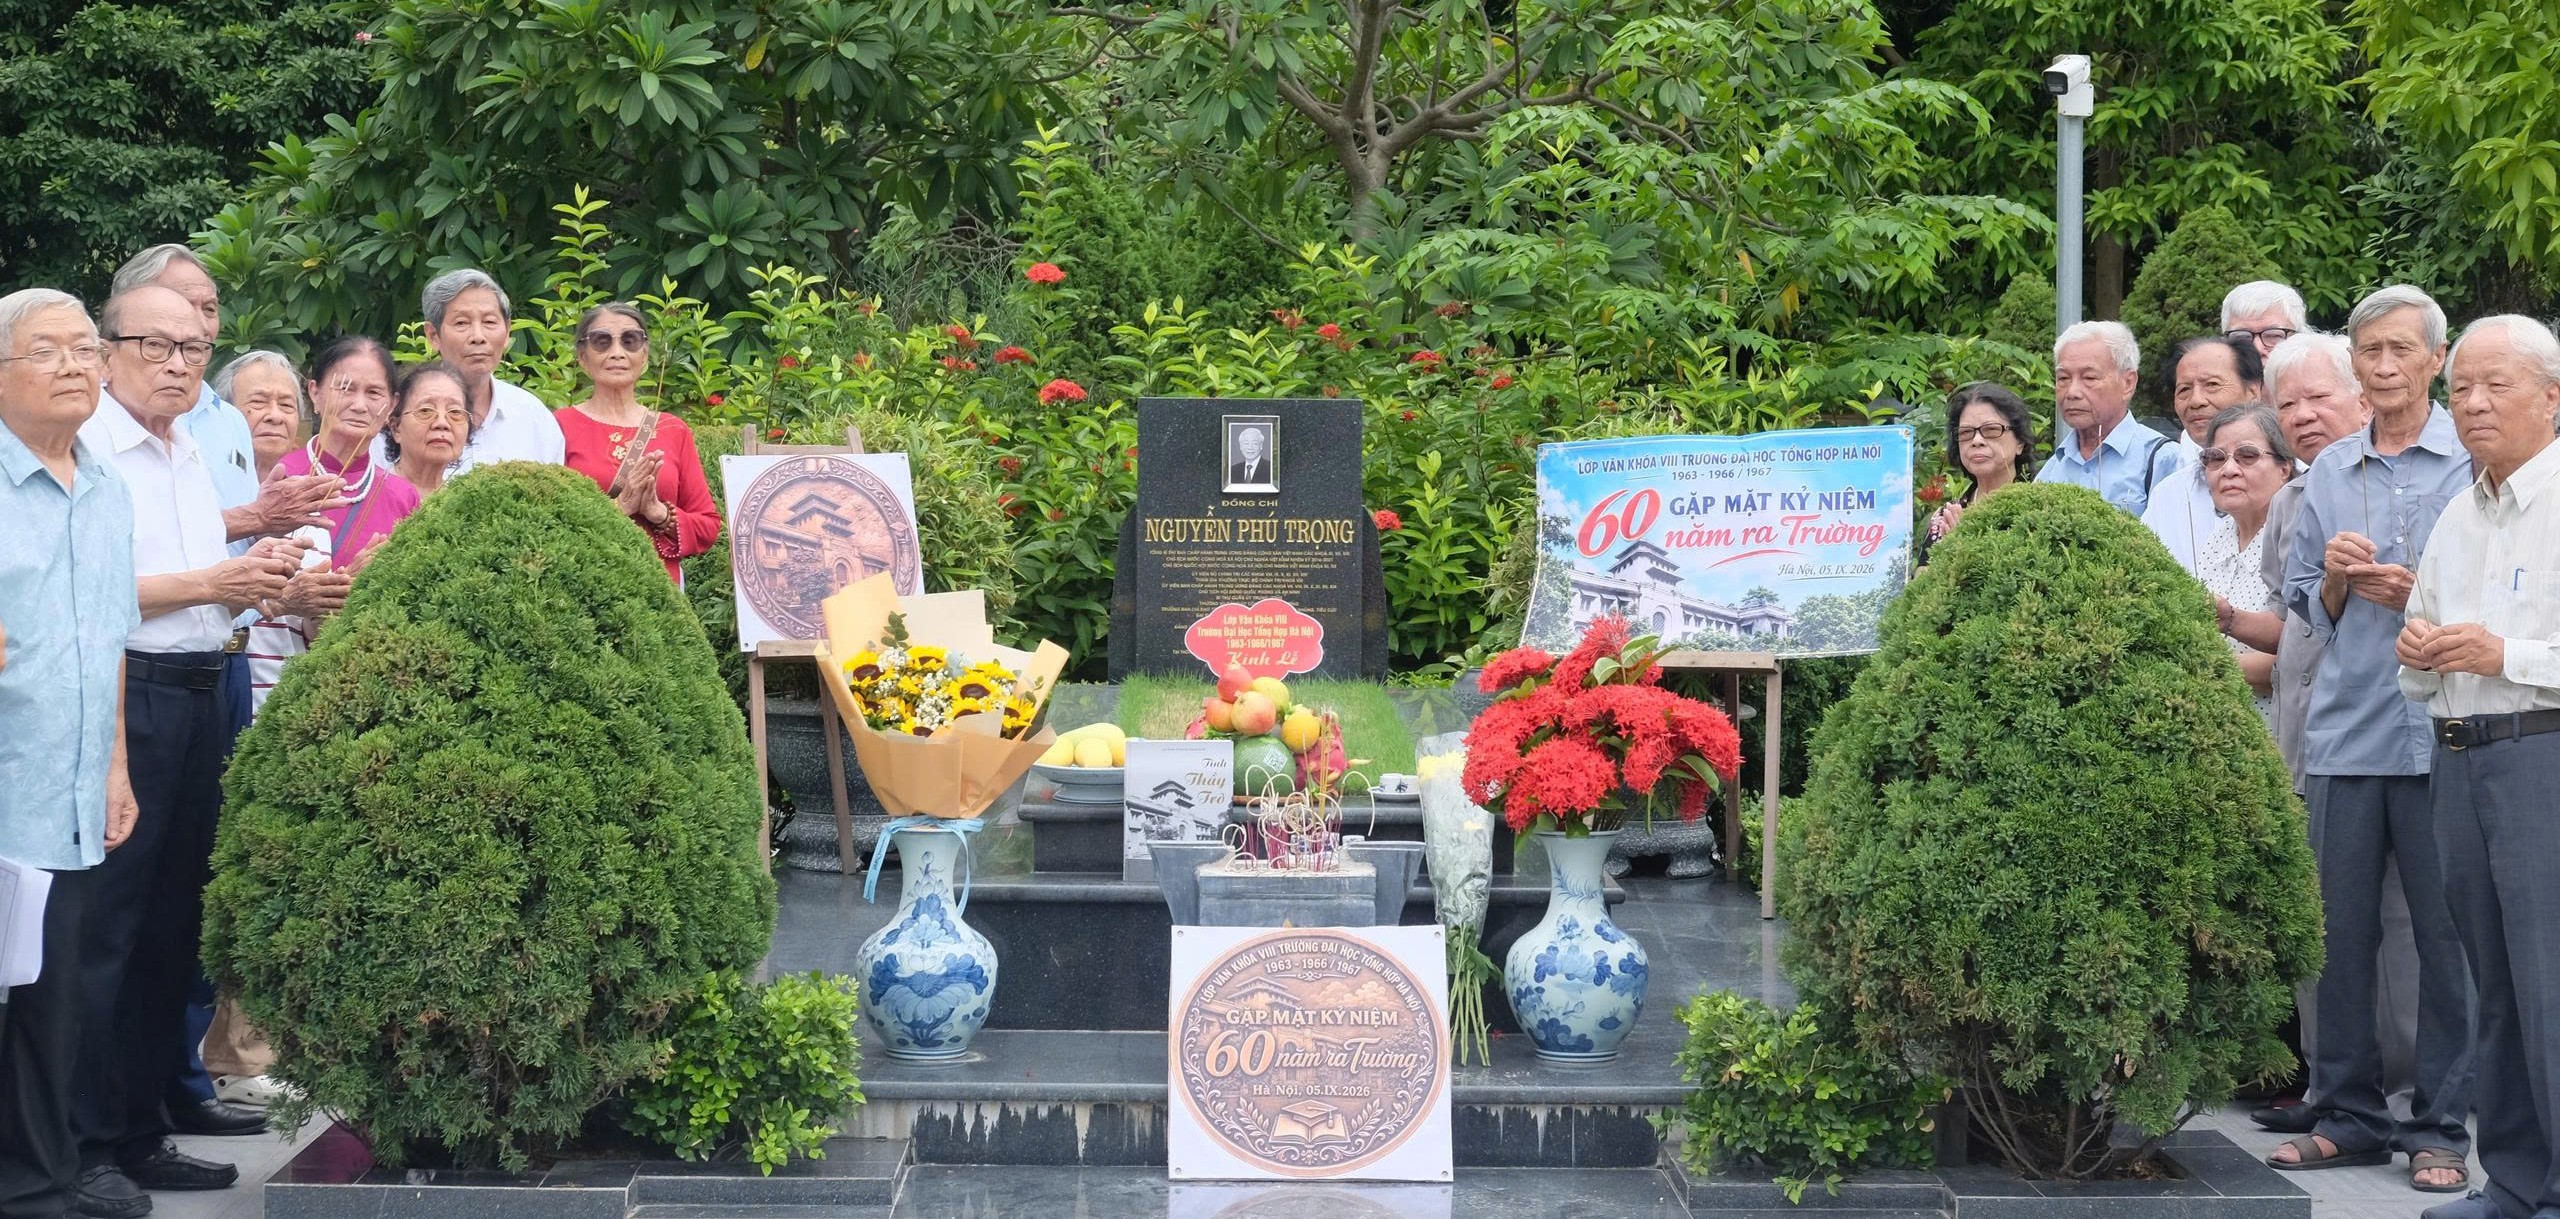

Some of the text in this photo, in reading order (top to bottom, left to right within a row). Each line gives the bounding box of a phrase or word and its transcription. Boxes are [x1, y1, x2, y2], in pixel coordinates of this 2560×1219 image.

[1578, 444, 1881, 475] LỚP VĂN KHÓA VIII TRƯỜNG ĐẠI HỌC TỔNG HỢP HÀ NỘI
[1672, 471, 1697, 481] 1963
[1708, 468, 1734, 479] 1966
[1747, 467, 1772, 477] 1967
[1221, 497, 1279, 507] ĐỒNG CHÍ
[1145, 505, 1355, 550] NGUYỄN PHÚ TRỌNG
[1577, 485, 1875, 558] 60 GẶP MẶT KỶ NIỆM
[1665, 513, 1888, 557] năm ra Trường
[1778, 563, 1795, 576] Hà
[1797, 564, 1816, 577] Nội,
[1850, 562, 1876, 574] 2026
[1275, 614, 1287, 624] VIII
[1223, 626, 1237, 638] Đại
[1238, 626, 1252, 638] Học
[1301, 626, 1314, 638] Nội
[1226, 651, 1299, 666] Kinh Lễ
[1200, 939, 1421, 1012] LỚP VĂN KHÓA VIII TRƯỜNG ĐẠI HỌC TỔNG HỢP HÀ NỘI
[1265, 959, 1292, 974] 1963
[1302, 958, 1328, 969] 1966
[1337, 961, 1361, 976] 1967
[1225, 1005, 1399, 1028] GẶP MẶT KỶ NIỆM
[1205, 1029, 1419, 1079] 60 năm ra Trường
[1252, 1084, 1371, 1098] Hà Nội, 05.IX.2026
